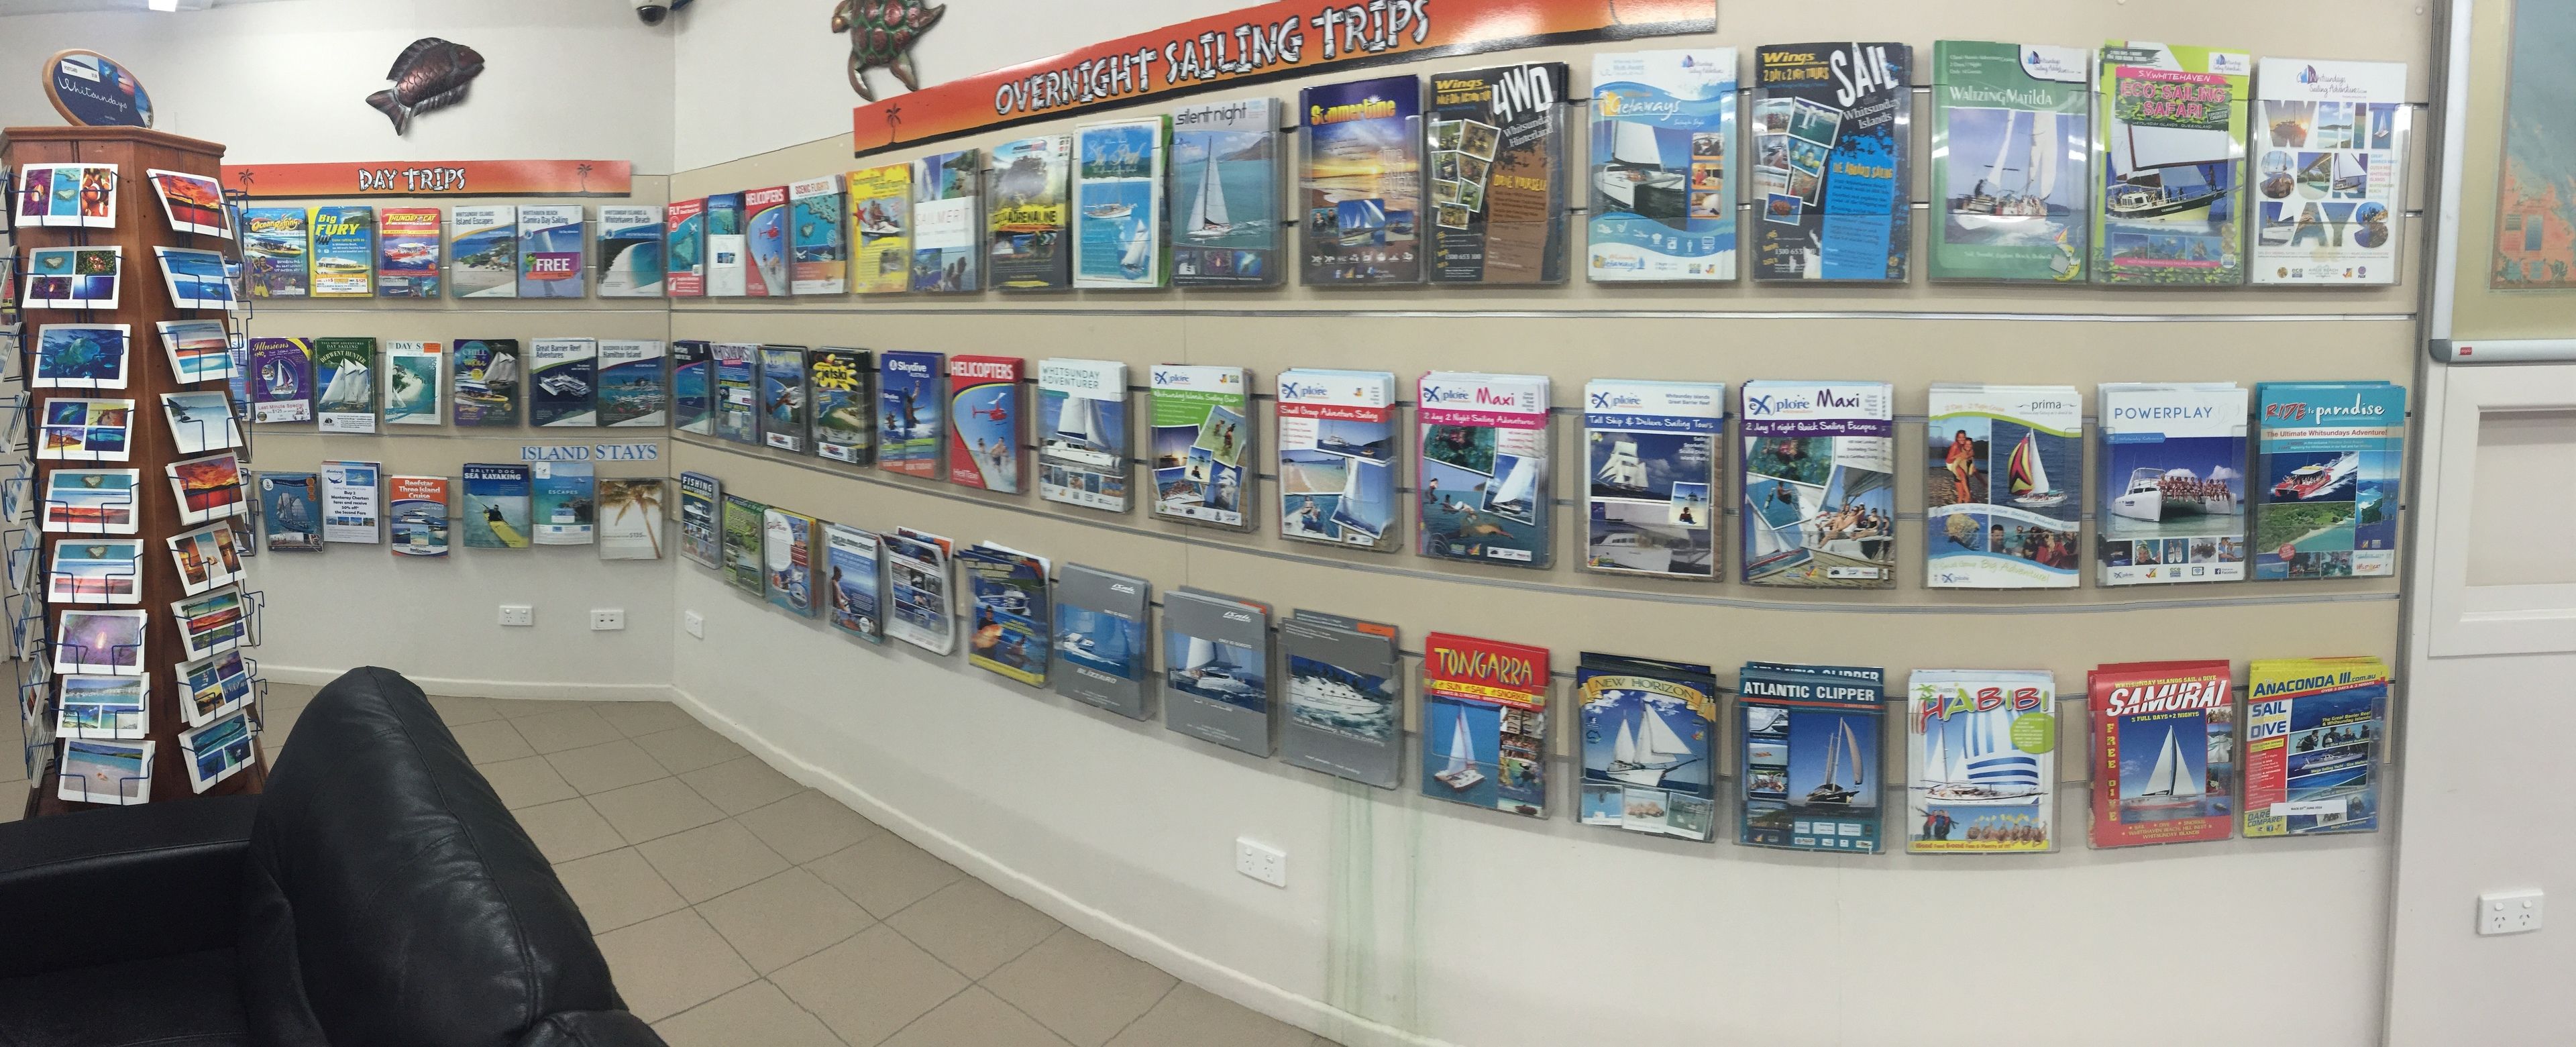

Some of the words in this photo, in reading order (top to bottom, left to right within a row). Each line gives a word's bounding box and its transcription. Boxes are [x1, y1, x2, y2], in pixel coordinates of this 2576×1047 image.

[995, 46, 1157, 114] OVERNIGHT
[1164, 14, 1303, 85] SAILING
[1311, 0, 1429, 60] TRIPS
[1762, 52, 1816, 63] Wings
[1830, 42, 1899, 107] SAIL
[1436, 79, 1483, 90] Wings
[2120, 81, 2156, 99] ECO
[2161, 85, 2226, 103] SAILING
[58, 76, 127, 112] Whitsundays
[1492, 64, 1554, 123] 4WD
[1175, 105, 1212, 125] silent
[1214, 102, 1248, 127] night
[1609, 96, 1682, 121] Getaways
[1843, 99, 1900, 121] Whitsunday
[2143, 101, 2203, 119] SAFARI
[1859, 113, 1892, 129] Islands
[2264, 100, 2398, 149] WHIT
[1509, 128, 1553, 147] Hinterland
[358, 168, 398, 191] DAY
[402, 167, 465, 191] TRIPS
[2259, 150, 2369, 199] SUN
[745, 189, 784, 207] HELICOPTERS
[668, 206, 680, 215] FLY
[1008, 210, 1057, 225] ADRENALINE
[318, 215, 337, 224] Big
[472, 217, 494, 225] Escapes
[541, 217, 551, 225] Day
[551, 216, 569, 225] Sailing
[2258, 201, 2390, 249] DAYS
[315, 223, 360, 236] FURY
[536, 258, 570, 272] FREE
[252, 341, 290, 351] Illusions
[320, 350, 344, 363] DERWENT
[345, 350, 367, 364] HUNTER
[897, 361, 927, 374] Skydive
[951, 361, 1014, 380] HELICOPTERS
[1042, 366, 1100, 380] WHITSUNDAY
[1042, 376, 1099, 390] ADVENTURER
[1477, 387, 1514, 406] Maxi
[1817, 388, 1860, 408] Maxi
[2031, 399, 2061, 411] prima
[2114, 407, 2212, 419] POWERPLAY
[2265, 402, 2307, 421] RIDE
[2316, 392, 2385, 425] paradise
[1281, 406, 1299, 414] Small
[1300, 406, 1319, 418] Group
[1321, 408, 1354, 418] Adventure
[1355, 410, 1379, 422] Sailing
[1452, 414, 1470, 423] Night
[1471, 415, 1495, 425] Sailing
[1497, 416, 1536, 425] Adventures
[1589, 416, 1603, 424] Tall
[1605, 417, 1623, 426] Ship
[1636, 417, 1663, 427] Deluxe
[1664, 419, 1690, 429] Sailing
[1693, 419, 1714, 429] Tours
[1746, 423, 1752, 431] 2
[1777, 423, 1796, 433] night
[1797, 423, 1819, 431] Quick
[1819, 421, 1845, 433] Sailing
[1847, 421, 1878, 432] Escapes
[521, 447, 590, 461] ISLAND
[596, 445, 657, 461] STAYS
[682, 476, 712, 492] FISHING
[1434, 647, 1533, 687] TONGARRA
[1594, 677, 1626, 691] NEW
[1631, 678, 1696, 700] HORIZON
[1743, 681, 1810, 698] ATLANTIC
[1816, 686, 1875, 702] CLIPPER
[2114, 679, 2156, 688] WHITSUNDAY
[2253, 674, 2334, 697] ANACONDA
[1472, 685, 1487, 694] SAIL
[1497, 689, 1531, 702] SNORKEL
[2106, 679, 2227, 717] SAMURAI
[1921, 687, 2049, 734] HABIBI
[2252, 701, 2287, 717] SAIL
[2251, 720, 2287, 738] DIVE
[2326, 718, 2353, 726] Whitsunday
[2247, 816, 2282, 827] COMPARE!
[2248, 812, 2270, 821] DARE
